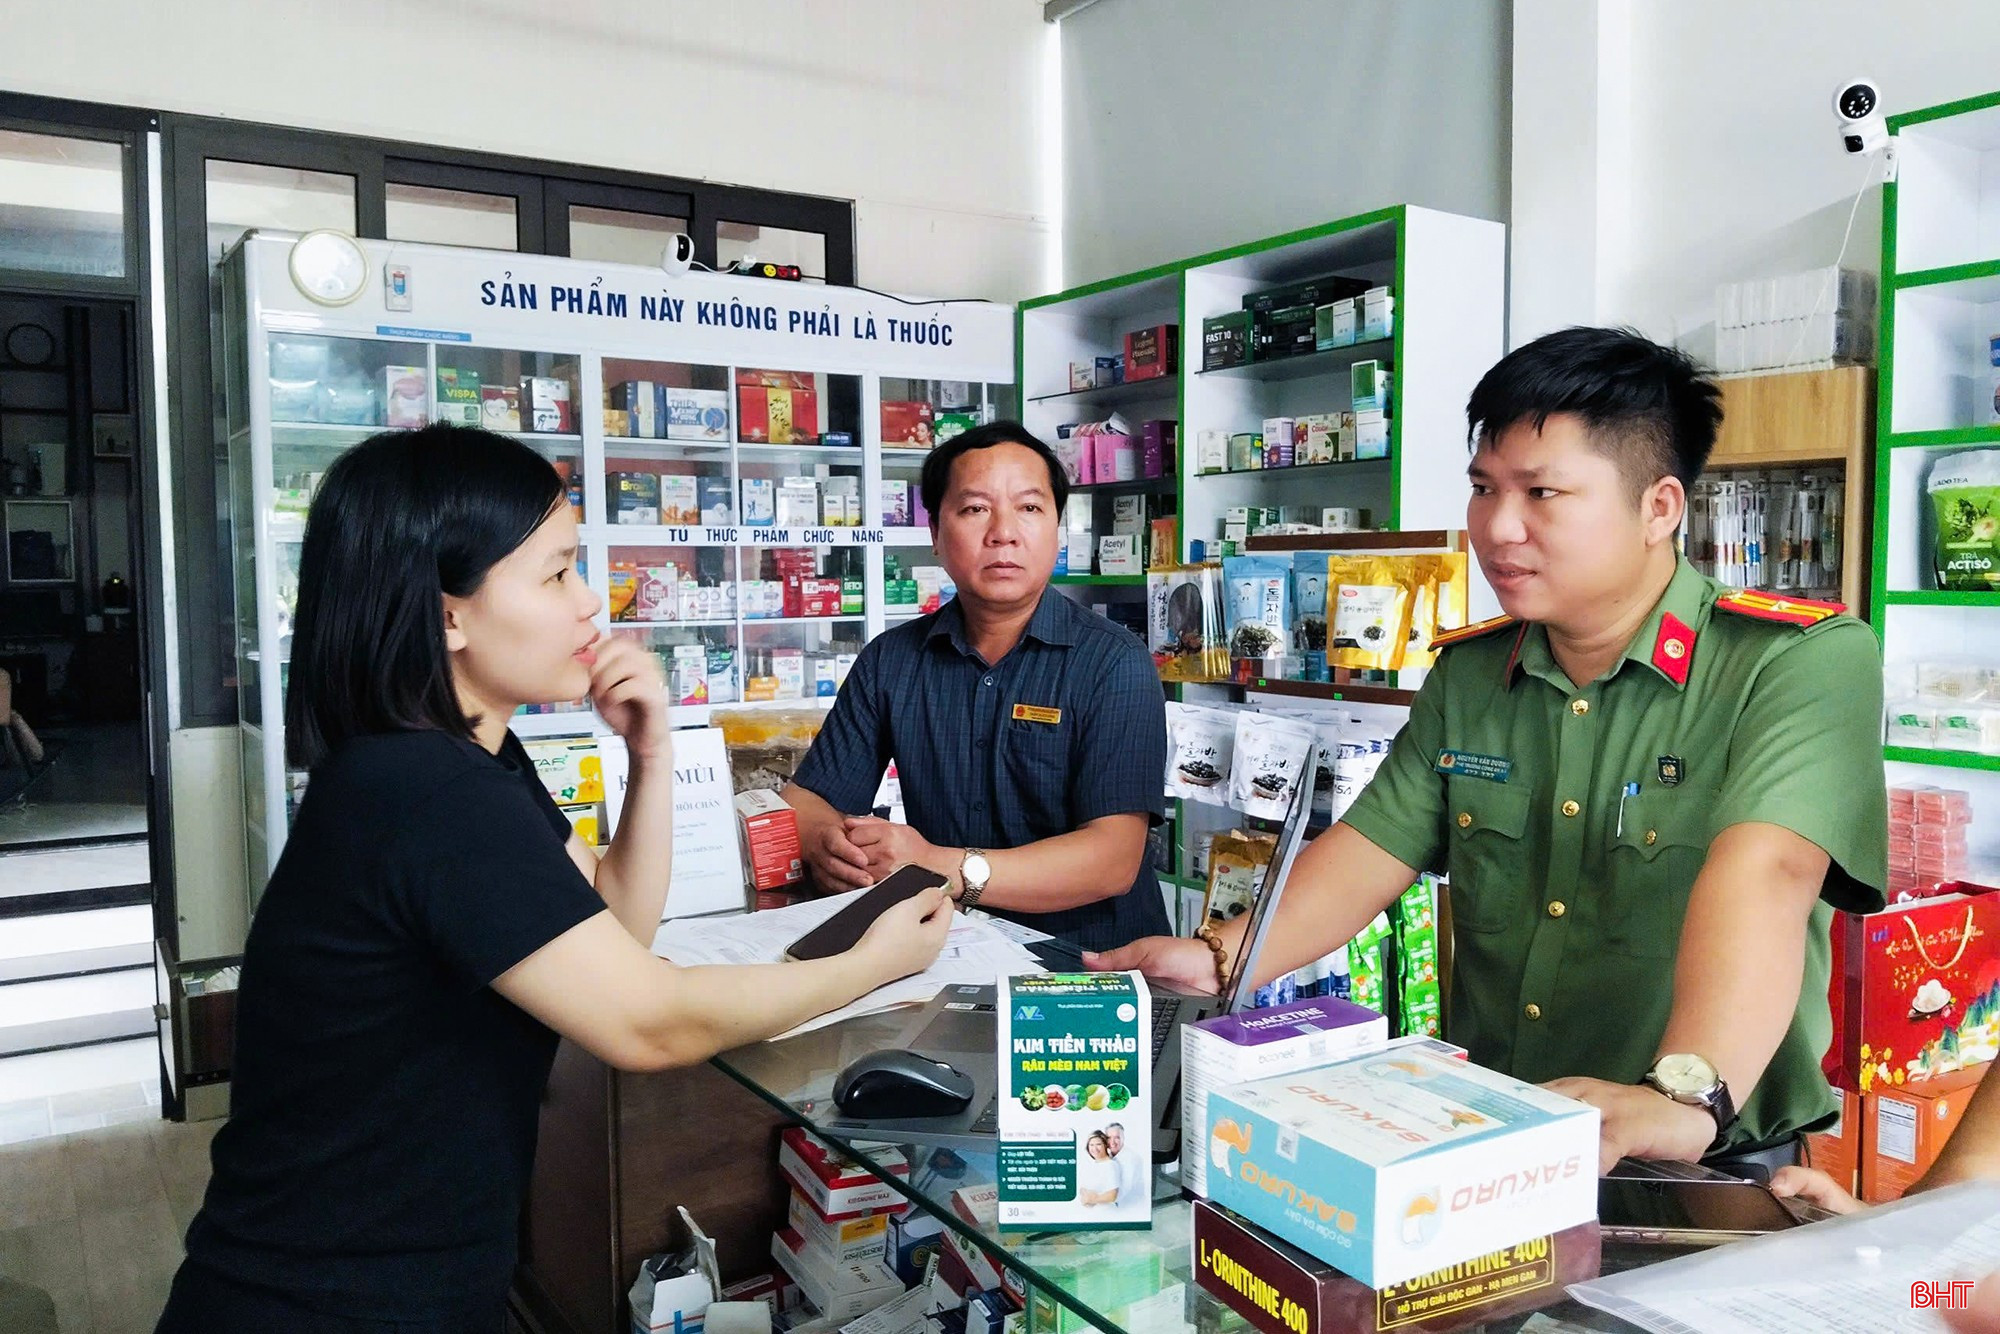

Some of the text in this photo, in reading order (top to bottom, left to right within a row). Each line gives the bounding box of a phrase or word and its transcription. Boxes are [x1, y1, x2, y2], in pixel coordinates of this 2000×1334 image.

[481, 271, 953, 346] SẢN PHẨM NÀY KHÔNG PHẢI LÀ THUỐC
[1206, 330, 1231, 343] FAST 10
[446, 388, 478, 399] VISPA
[706, 527, 738, 545] THỰC
[1104, 540, 1126, 550] Acetyl
[1947, 558, 1992, 570] ACTISÔ
[807, 582, 840, 593] Ferrolip
[675, 763, 716, 785] MÙI
[1014, 1033, 1136, 1053] KIM TIỀN THẢO
[1075, 1060, 1099, 1071] NAM
[1103, 1059, 1128, 1072] VIỆT
[1286, 1085, 1430, 1142] SAKURO
[1451, 1156, 1581, 1212] SAKURO
[970, 1190, 997, 1204] KIDS
[1007, 1207, 1020, 1217] 30
[1513, 1236, 1548, 1262] 400
[1412, 1297, 1428, 1311] TRỢ
[1447, 1288, 1464, 1302] ĐỘC
[1465, 1284, 1483, 1296] GAN
[1488, 1280, 1500, 1290] HẠ
[1501, 1275, 1519, 1287] MEN
[1520, 1270, 1536, 1282] GAN
[1281, 1297, 1308, 1334] 400
